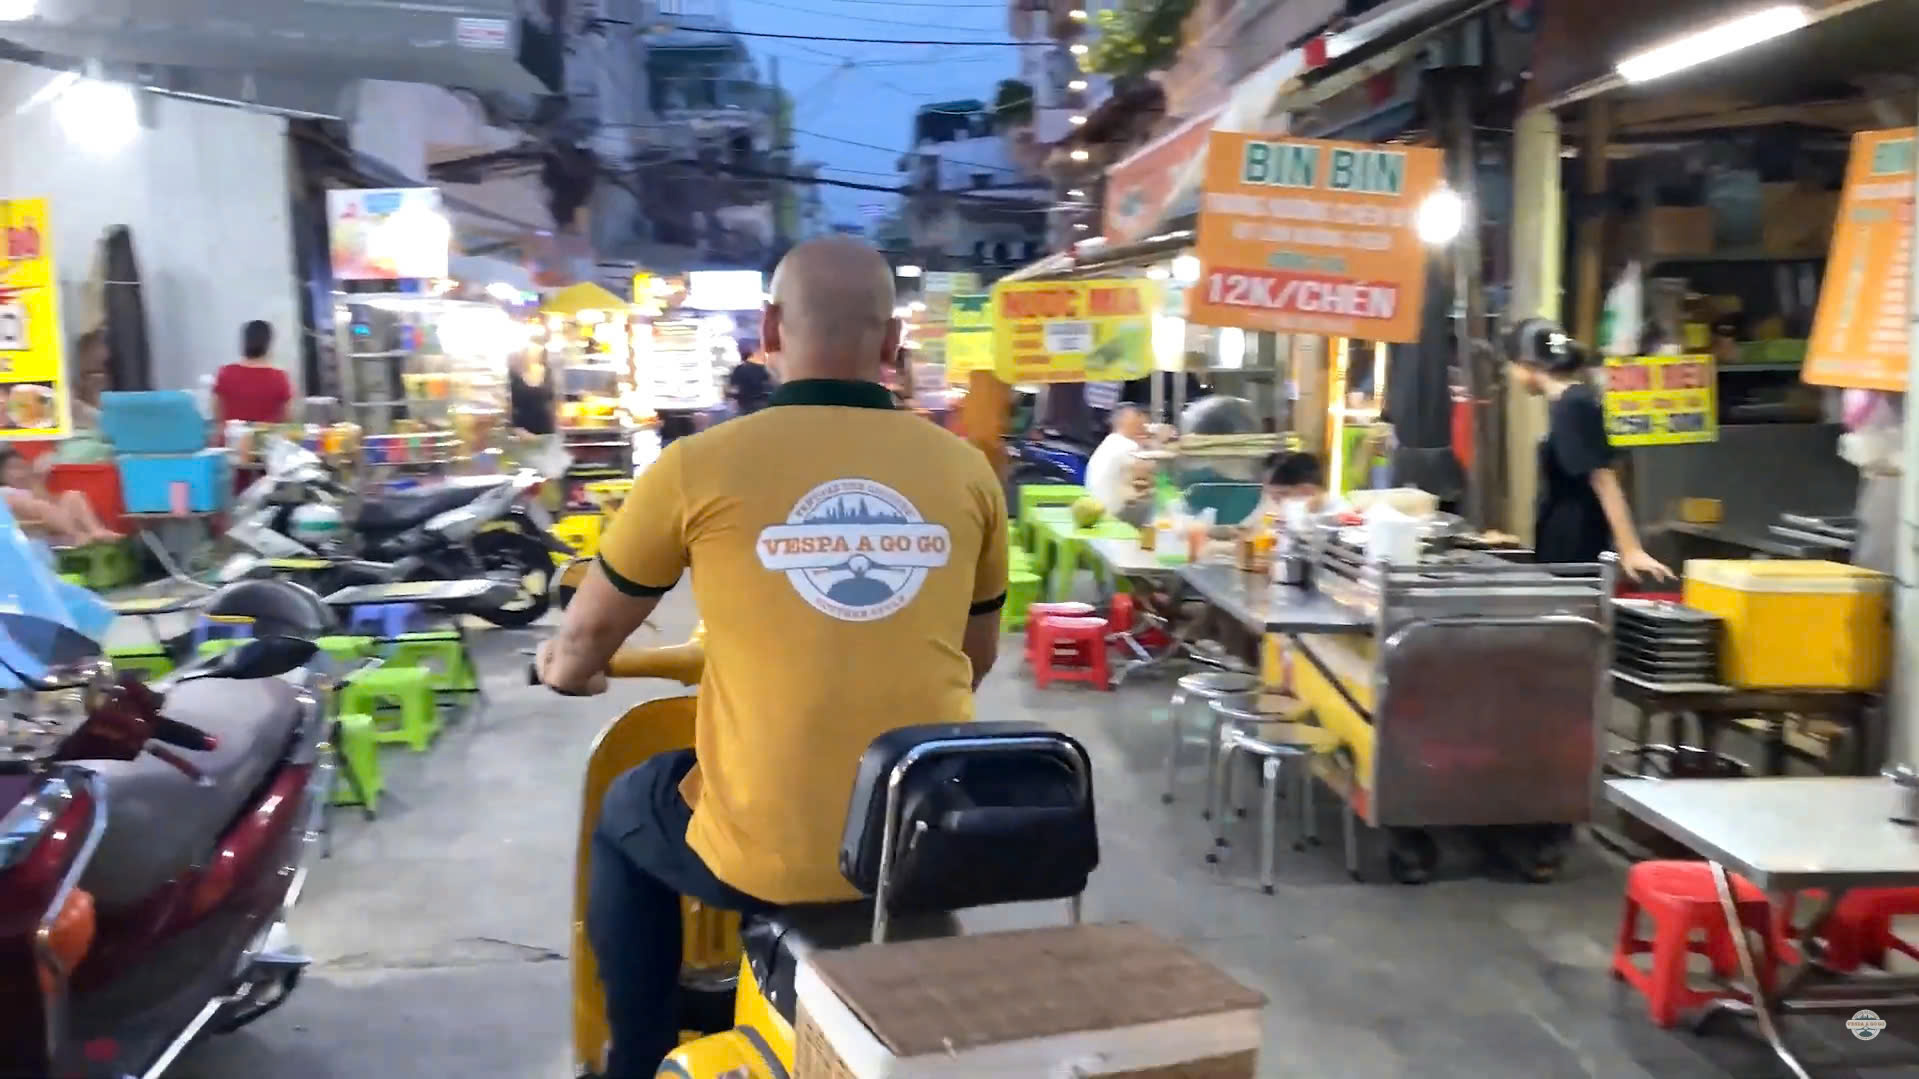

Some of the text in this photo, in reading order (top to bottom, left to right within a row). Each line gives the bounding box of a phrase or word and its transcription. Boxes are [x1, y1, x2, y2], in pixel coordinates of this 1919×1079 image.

[1243, 140, 1405, 194] BIN BIN
[762, 535, 946, 556] VESPA A GO GO
